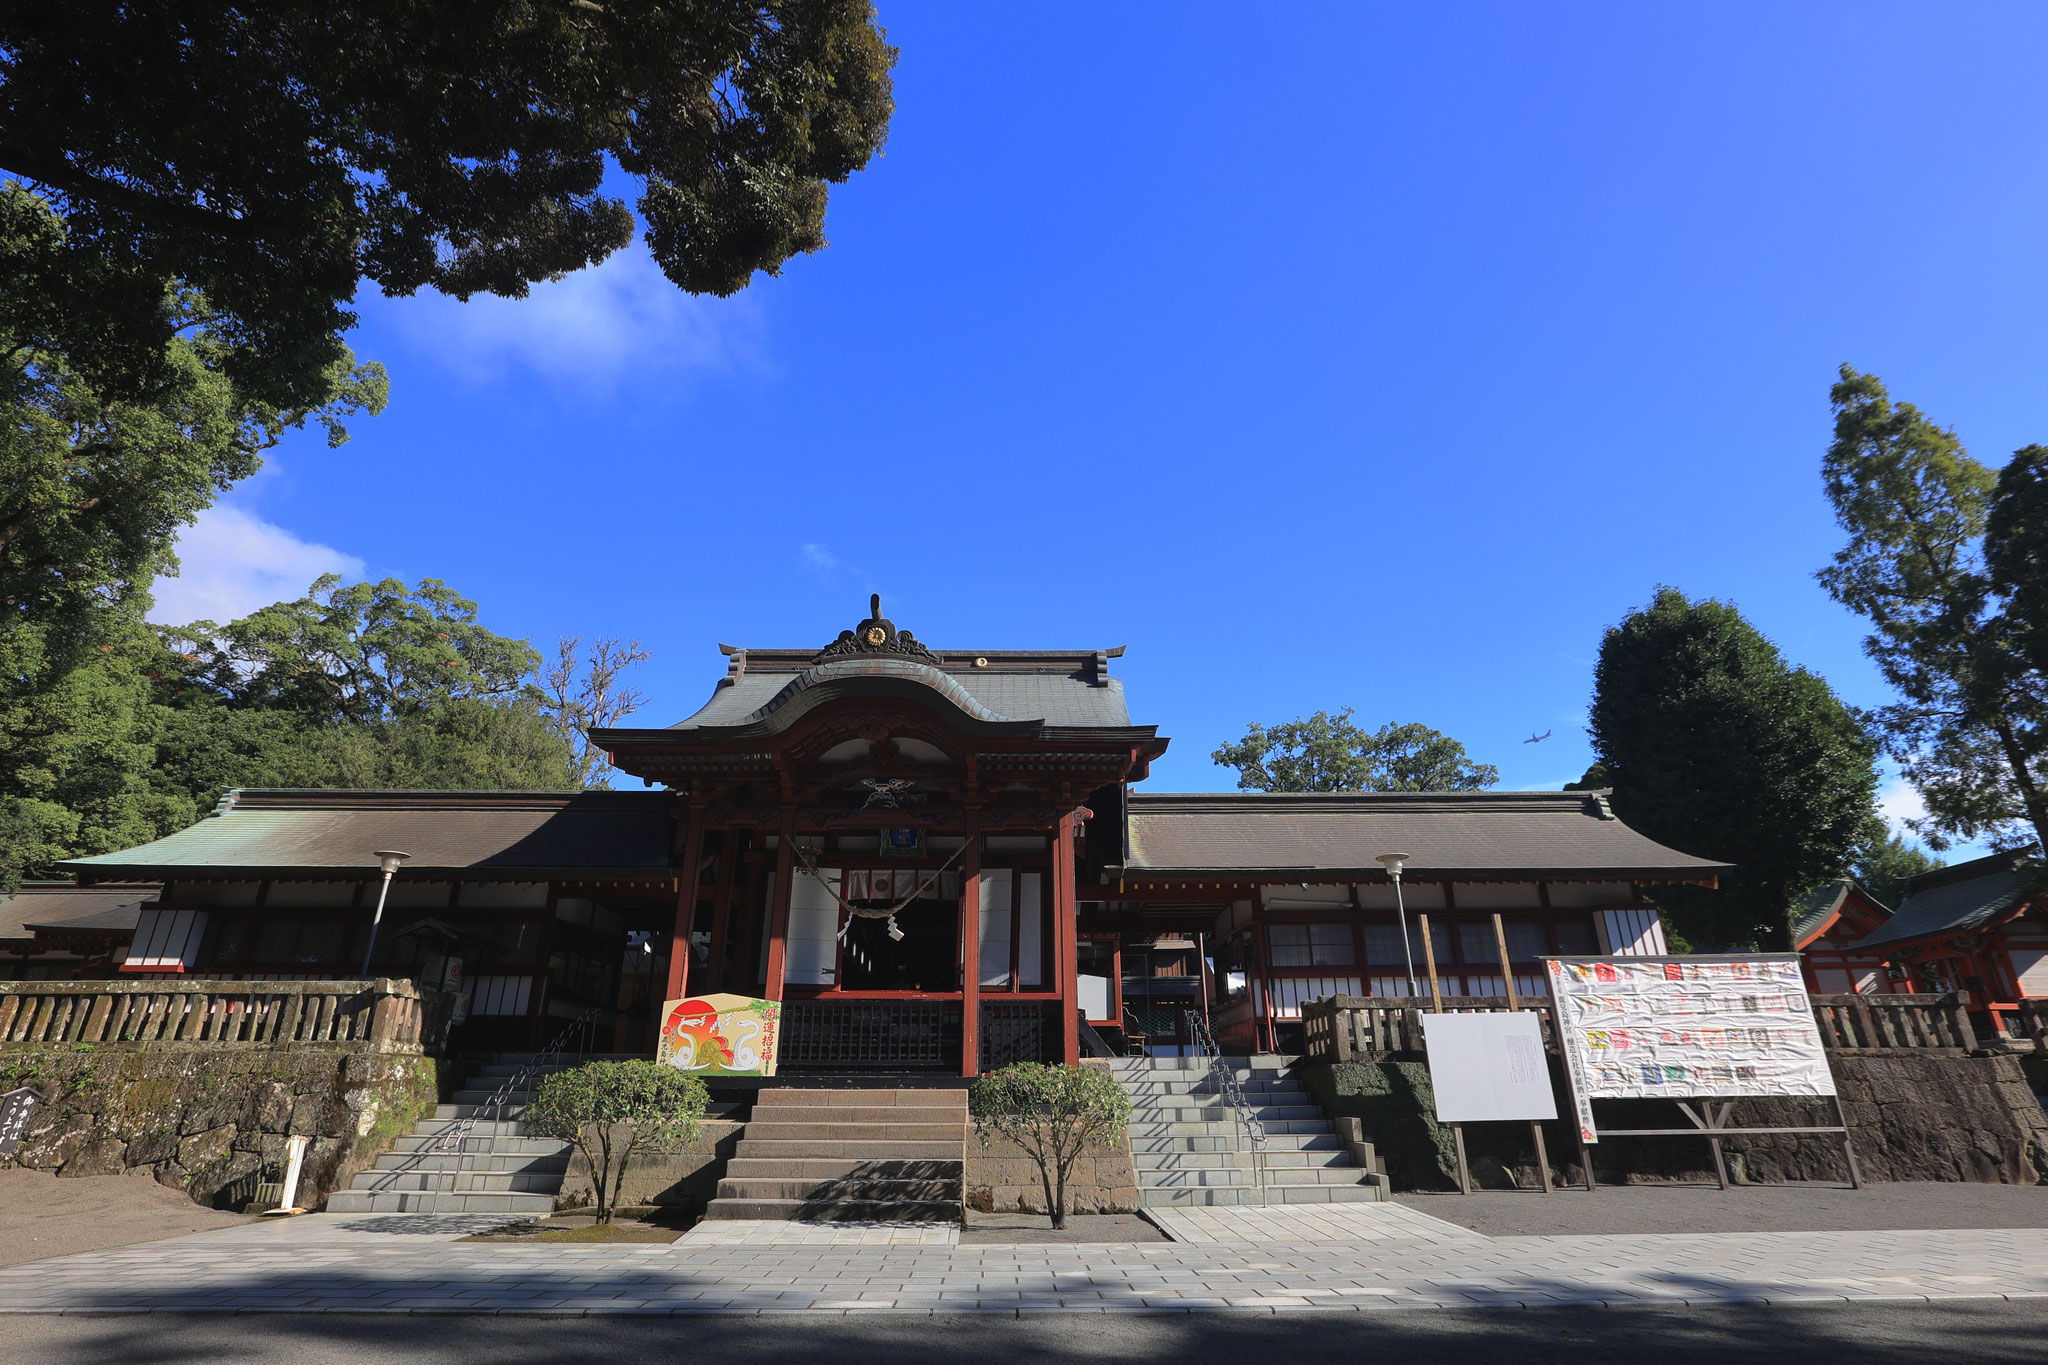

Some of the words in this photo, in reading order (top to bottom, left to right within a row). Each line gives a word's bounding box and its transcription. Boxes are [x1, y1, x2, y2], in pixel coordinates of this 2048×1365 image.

[760, 1008, 776, 1061] 開運招福
[10, 1095, 35, 1140] 御参拝は
